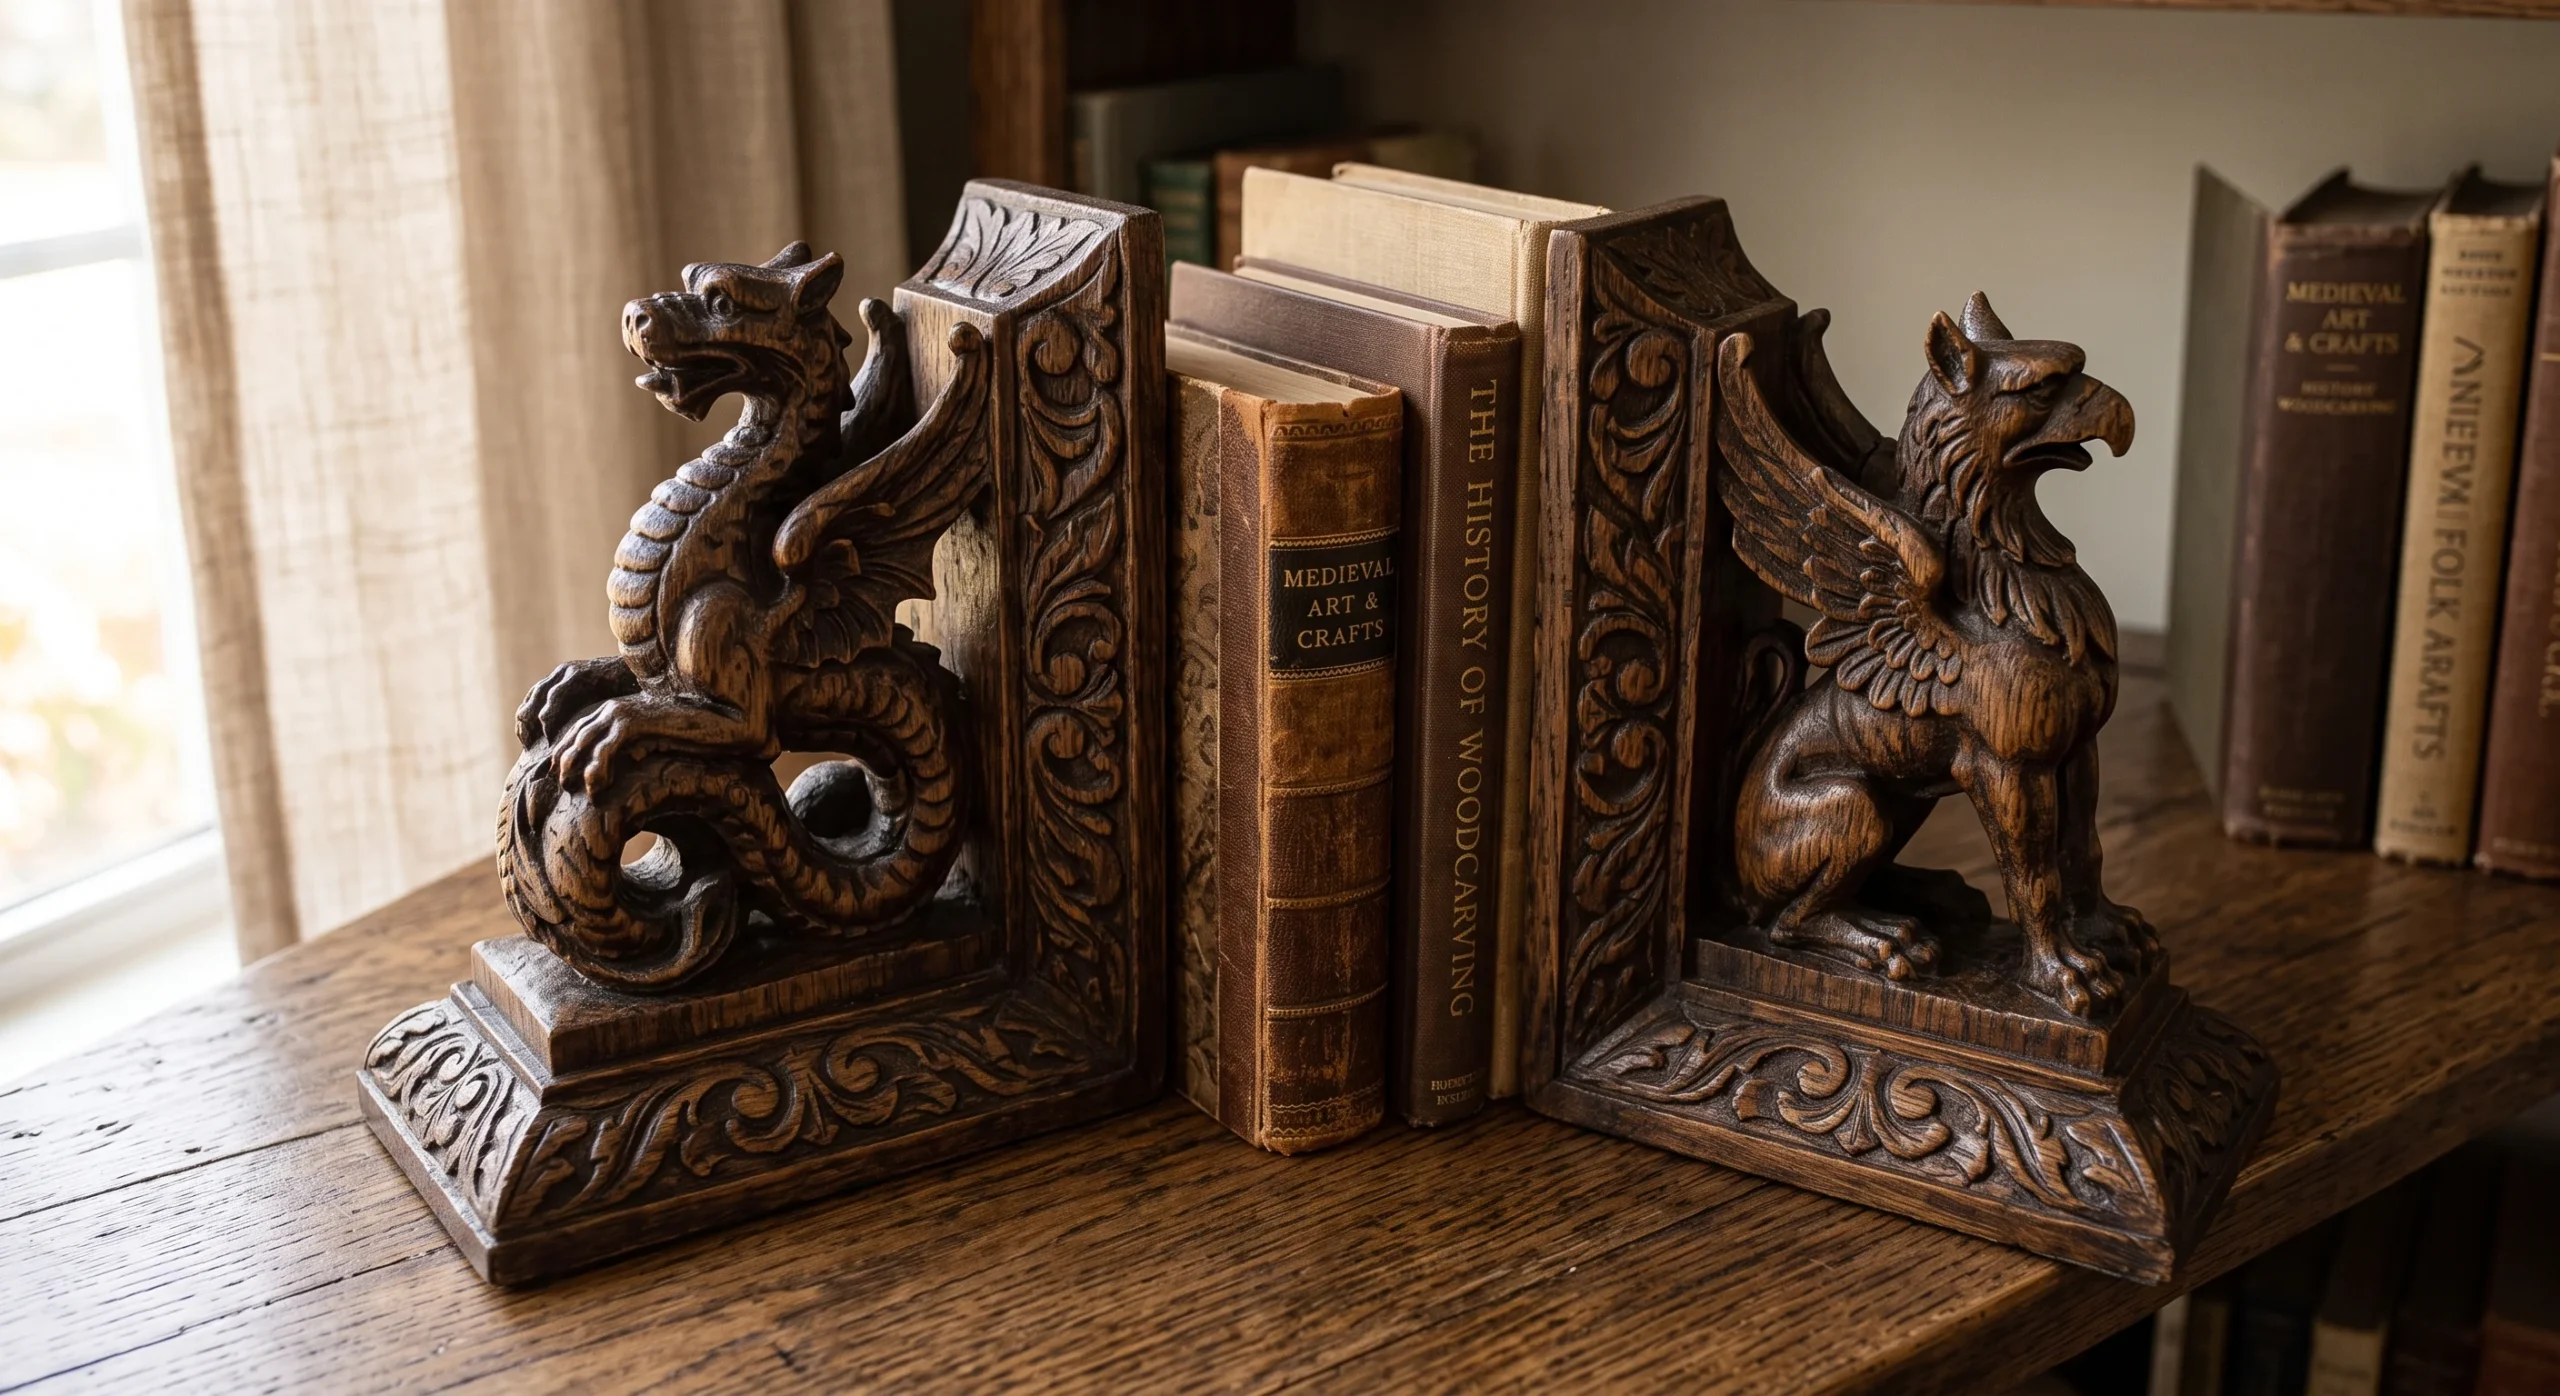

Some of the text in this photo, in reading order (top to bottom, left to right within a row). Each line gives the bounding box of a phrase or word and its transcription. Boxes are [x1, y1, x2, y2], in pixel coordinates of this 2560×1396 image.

[2286, 282, 2405, 304] MEDIEVAL
[2322, 309, 2371, 330] ART
[2285, 333, 2399, 355] & CRAFTS
[1283, 556, 1395, 588] MEDIEVAL
[2427, 528, 2467, 620] FOLK
[1307, 591, 1379, 618] ART &
[1297, 618, 1384, 649] CRAFTS
[1451, 379, 1497, 1018] THE HISTORY OF WOODCARVING
